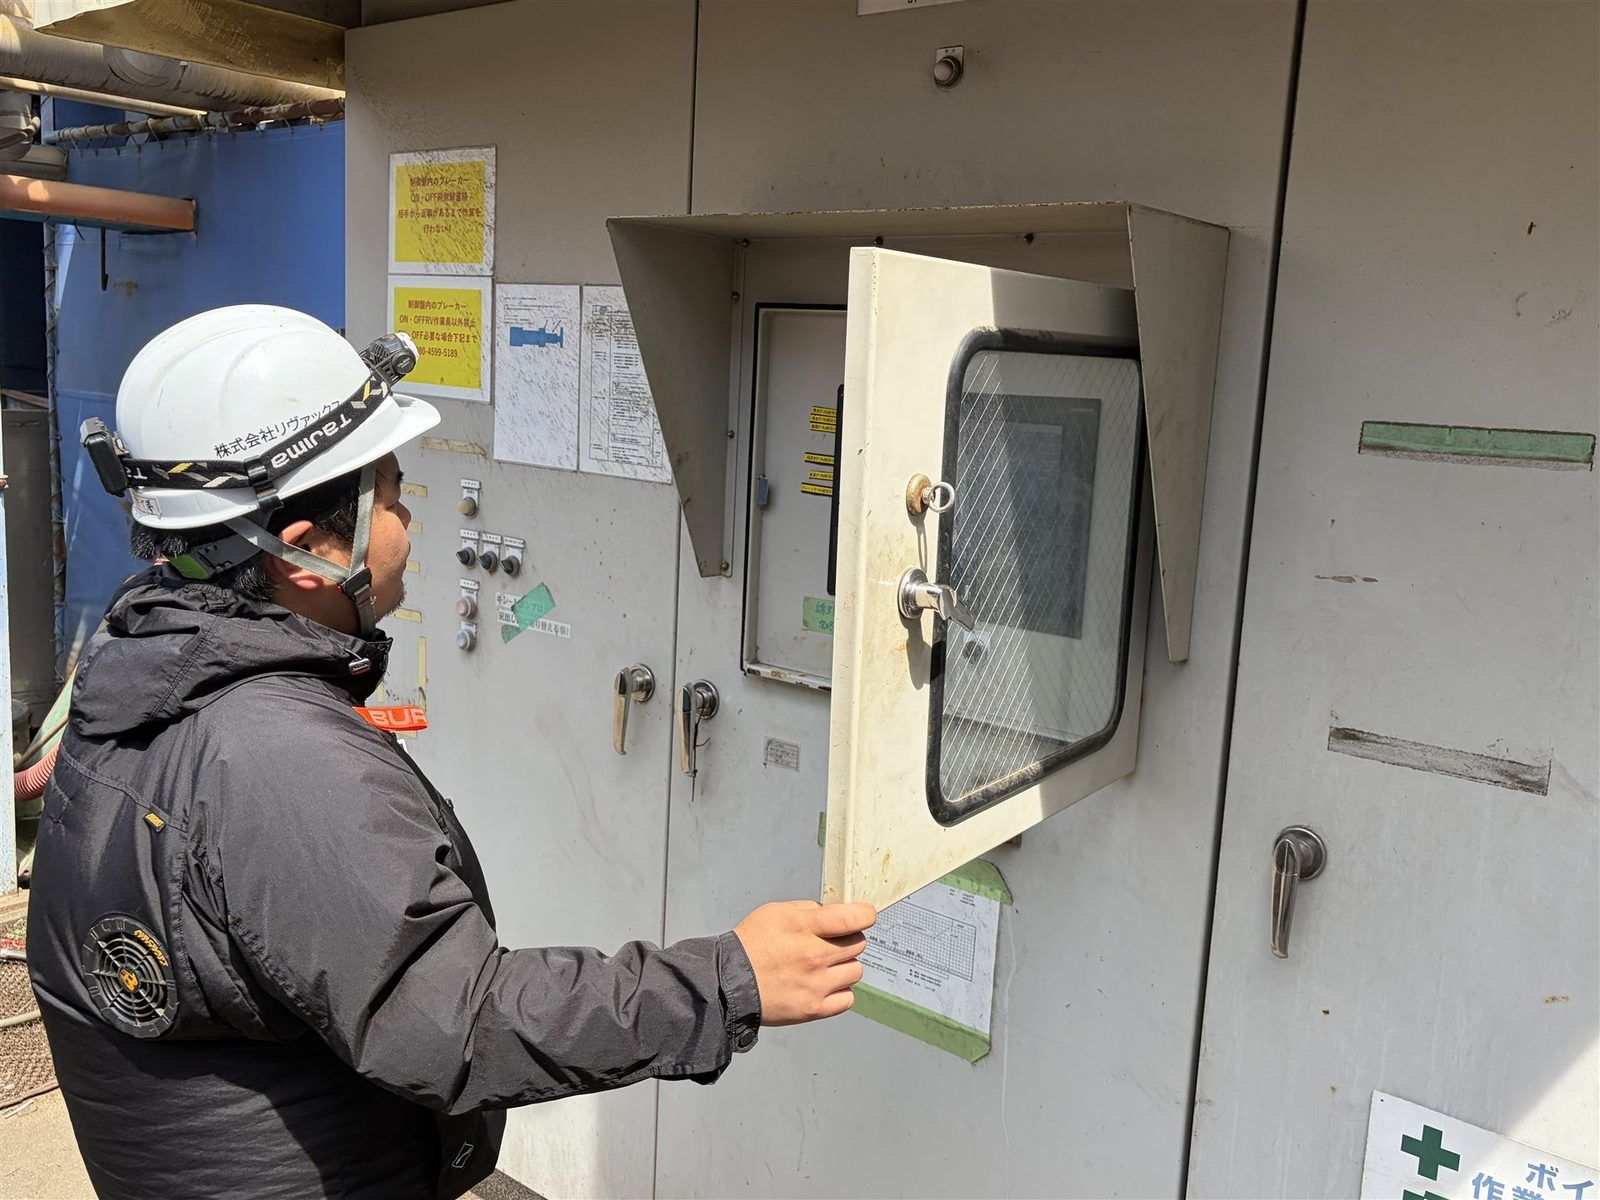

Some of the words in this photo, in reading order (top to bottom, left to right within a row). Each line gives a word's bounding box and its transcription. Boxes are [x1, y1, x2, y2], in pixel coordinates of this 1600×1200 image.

[408, 299, 467, 311] 制御盤内のブレーカー
[419, 346, 458, 358] 80-4599-5189
